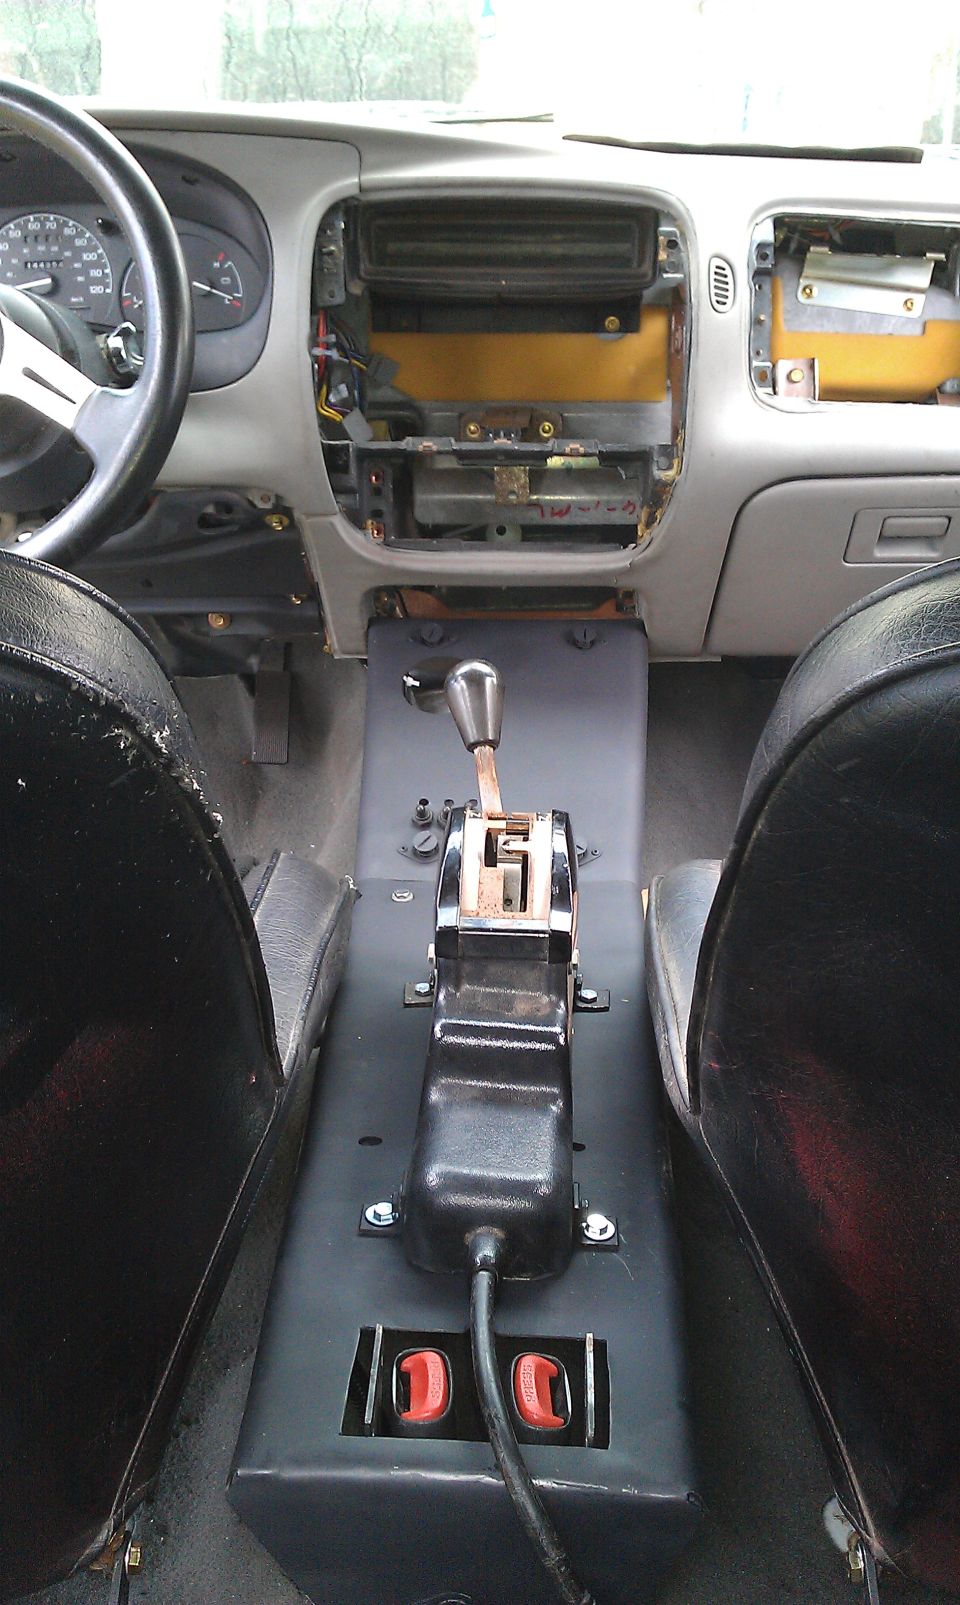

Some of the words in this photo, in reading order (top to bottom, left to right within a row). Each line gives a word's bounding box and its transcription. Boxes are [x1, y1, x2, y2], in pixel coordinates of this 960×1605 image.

[45, 222, 57, 230] 70
[82, 253, 98, 261] 100
[89, 286, 104, 294] 120
[521, 1363, 536, 1402] PRESS
